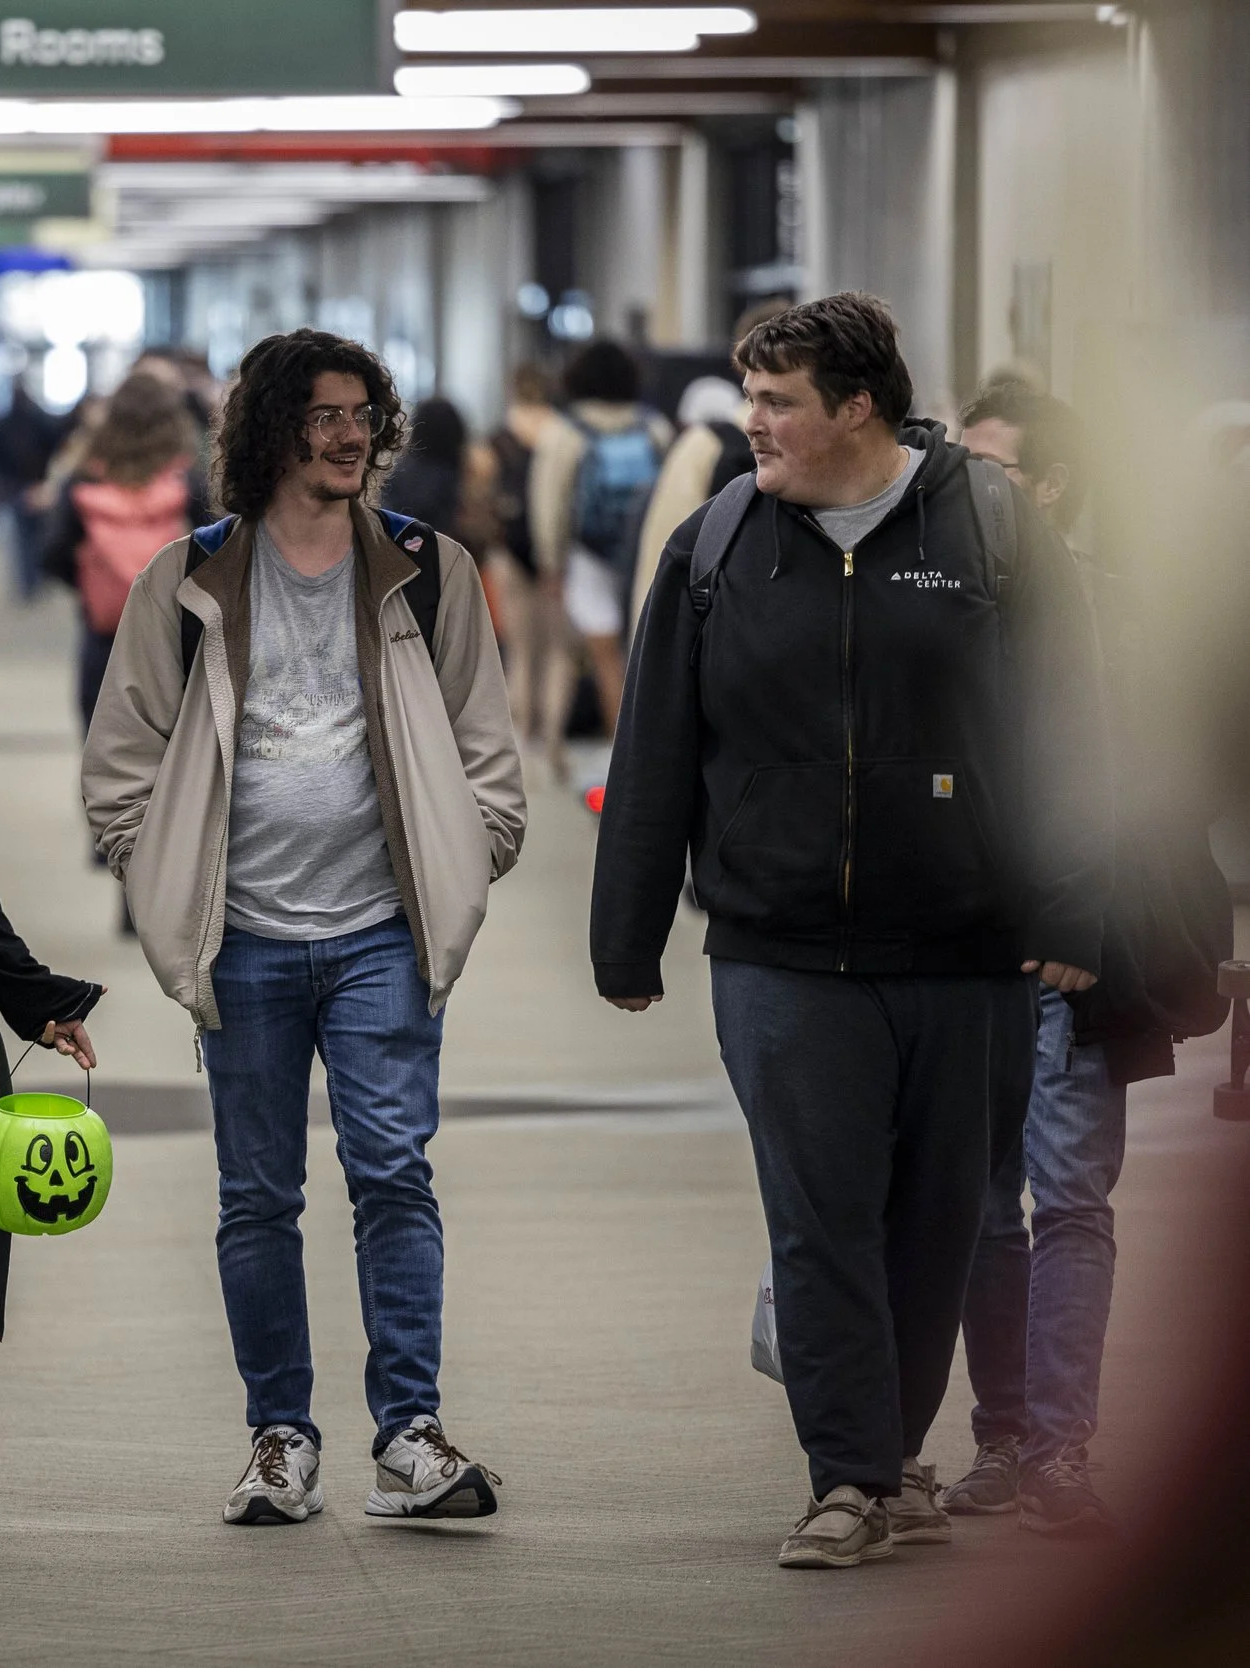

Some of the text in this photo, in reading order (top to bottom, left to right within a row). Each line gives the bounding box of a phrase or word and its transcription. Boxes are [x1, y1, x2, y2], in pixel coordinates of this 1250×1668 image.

[0, 18, 165, 66] Rooms
[904, 571, 943, 580] DELTA
[916, 580, 961, 589] CENTER
[388, 629, 421, 643] abela's
